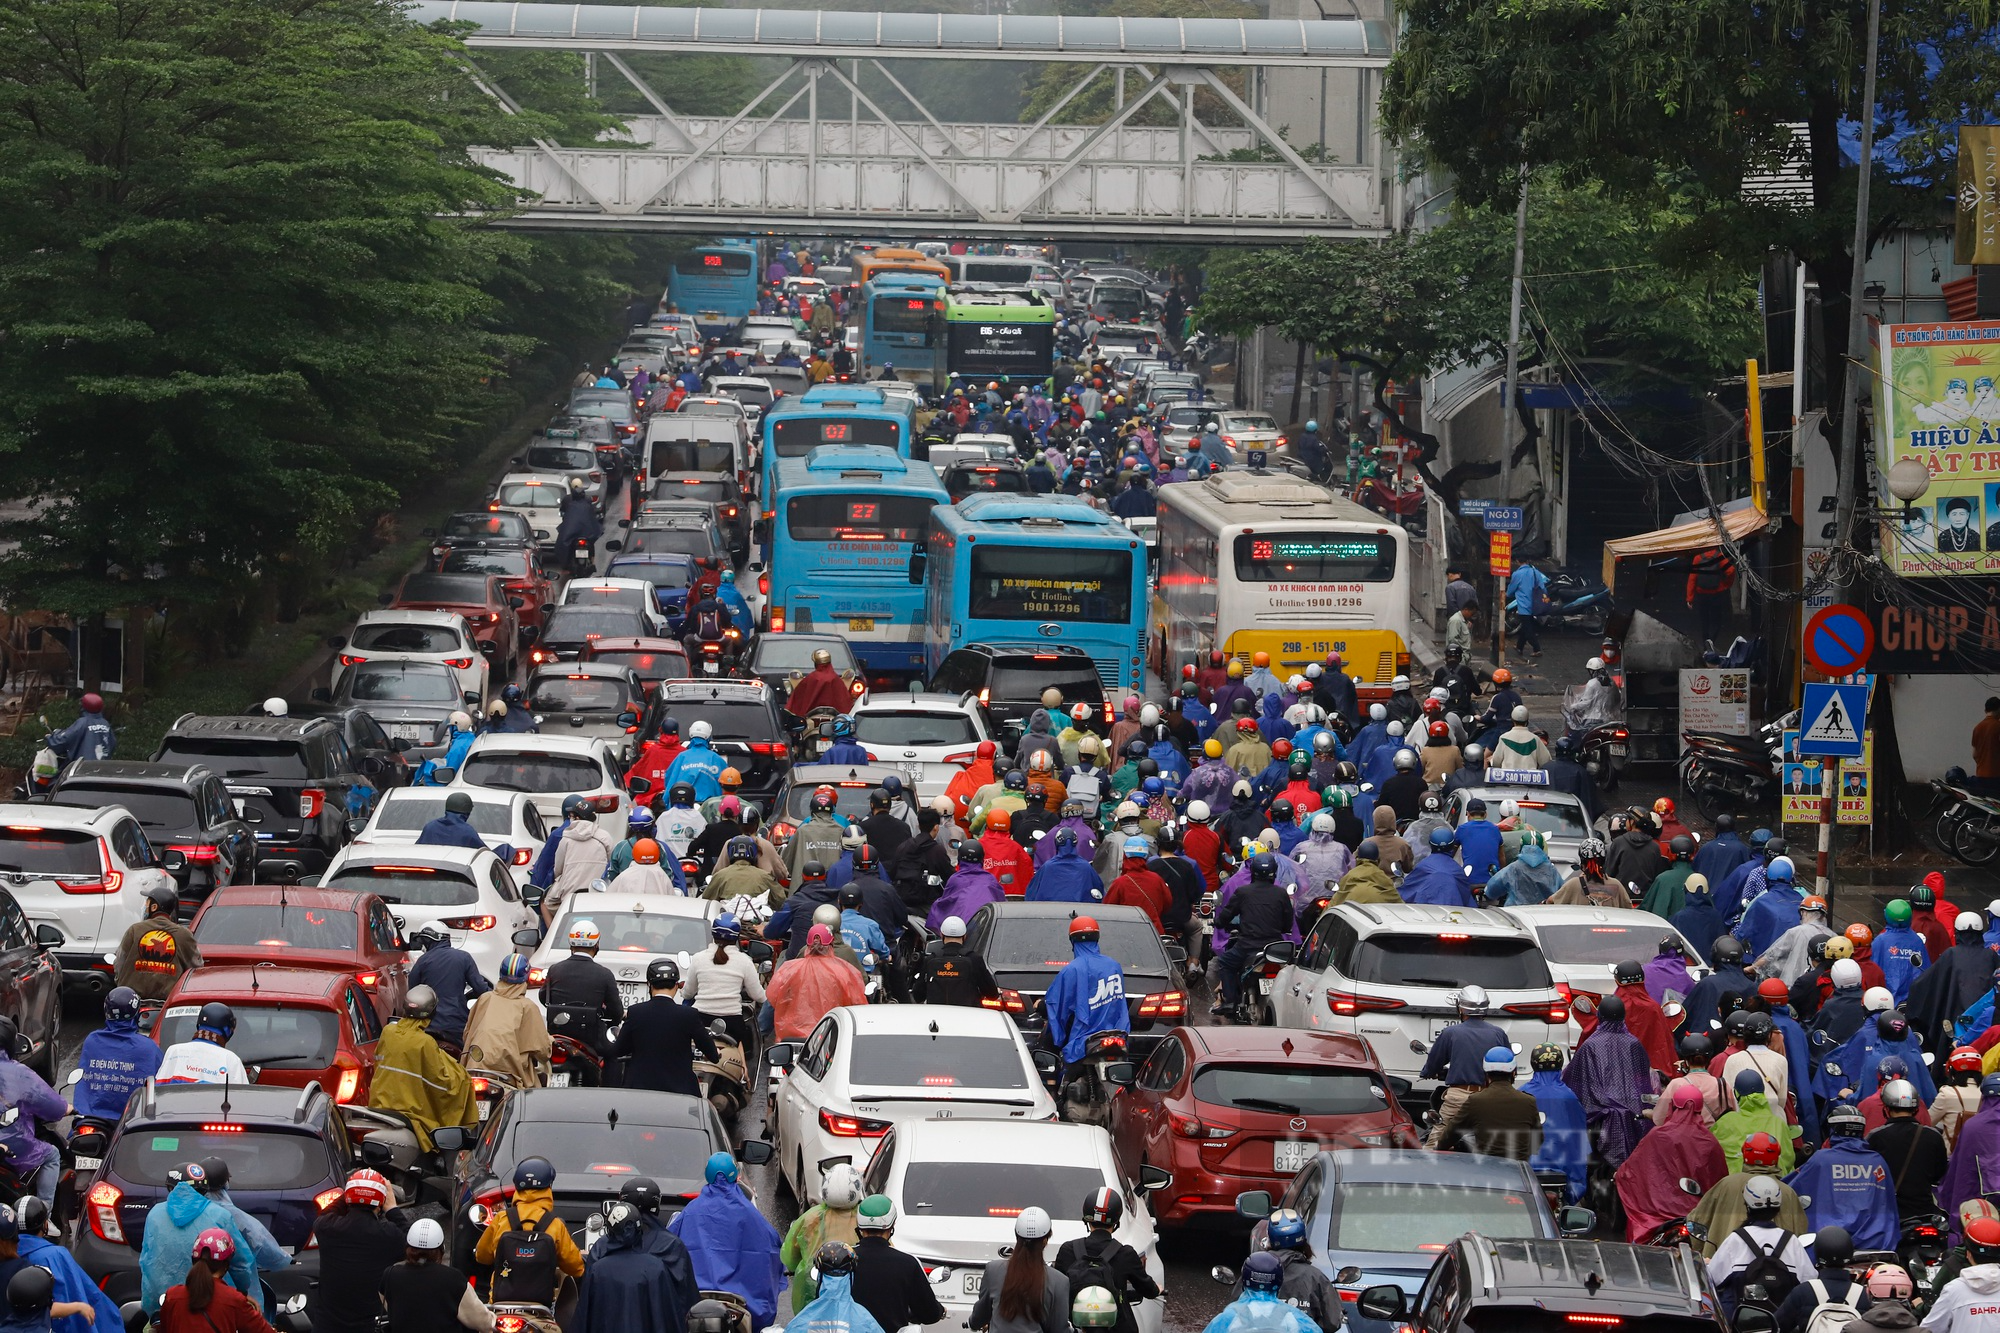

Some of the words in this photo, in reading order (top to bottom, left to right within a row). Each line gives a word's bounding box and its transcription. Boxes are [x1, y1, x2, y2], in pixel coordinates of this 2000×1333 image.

[1983, 146, 1998, 246] SKYMOND
[1896, 329, 1906, 345] HỆ
[1907, 327, 1930, 342] THỐNG
[1931, 326, 1945, 341] CỦA
[1946, 327, 1965, 341] HÀNG
[1966, 325, 1980, 340] ẢNH
[825, 424, 847, 439] 07
[1910, 424, 1970, 449] HIỆU
[852, 503, 876, 518] 27
[1489, 509, 1510, 519] NGÕ
[1512, 511, 1518, 519] 3
[851, 543, 870, 552] ĐIỆN
[883, 542, 899, 553] NỘI
[857, 557, 905, 566] 1900.1296
[1902, 560, 1925, 575] Phục
[1945, 556, 1962, 571] ảnh
[1014, 579, 1024, 588] XE
[1291, 583, 1317, 592] KHÁCH
[1349, 583, 1364, 593] NỘI
[1041, 592, 1073, 602] Hotline
[1275, 599, 1305, 607] Hotline
[1306, 598, 1362, 607] 1900.1296
[835, 601, 852, 611] 29B
[860, 601, 891, 612] 415.30
[1022, 602, 1081, 613] 1900.1296
[1881, 605, 1969, 662] CHỤP
[1282, 642, 1302, 653] 29B
[1312, 641, 1346, 653] 151.98
[903, 762, 917, 772] 30E
[1505, 772, 1518, 782] SAO
[1787, 796, 1821, 810] ẢNH
[1837, 797, 1865, 810] HẺ
[1841, 813, 1856, 821] Các
[618, 983, 639, 995] 30F
[1088, 973, 1123, 1005] MB
[96, 1060, 107, 1070] ĐIỆN
[107, 1059, 119, 1070] ĐỨC
[119, 1062, 134, 1073] THỊNH
[186, 1065, 218, 1077] VietinBank
[1285, 1142, 1308, 1156] 30F
[77, 1158, 100, 1169] 05.96
[1831, 1164, 1873, 1180] BIDV
[1299, 1299, 1311, 1308] Life
